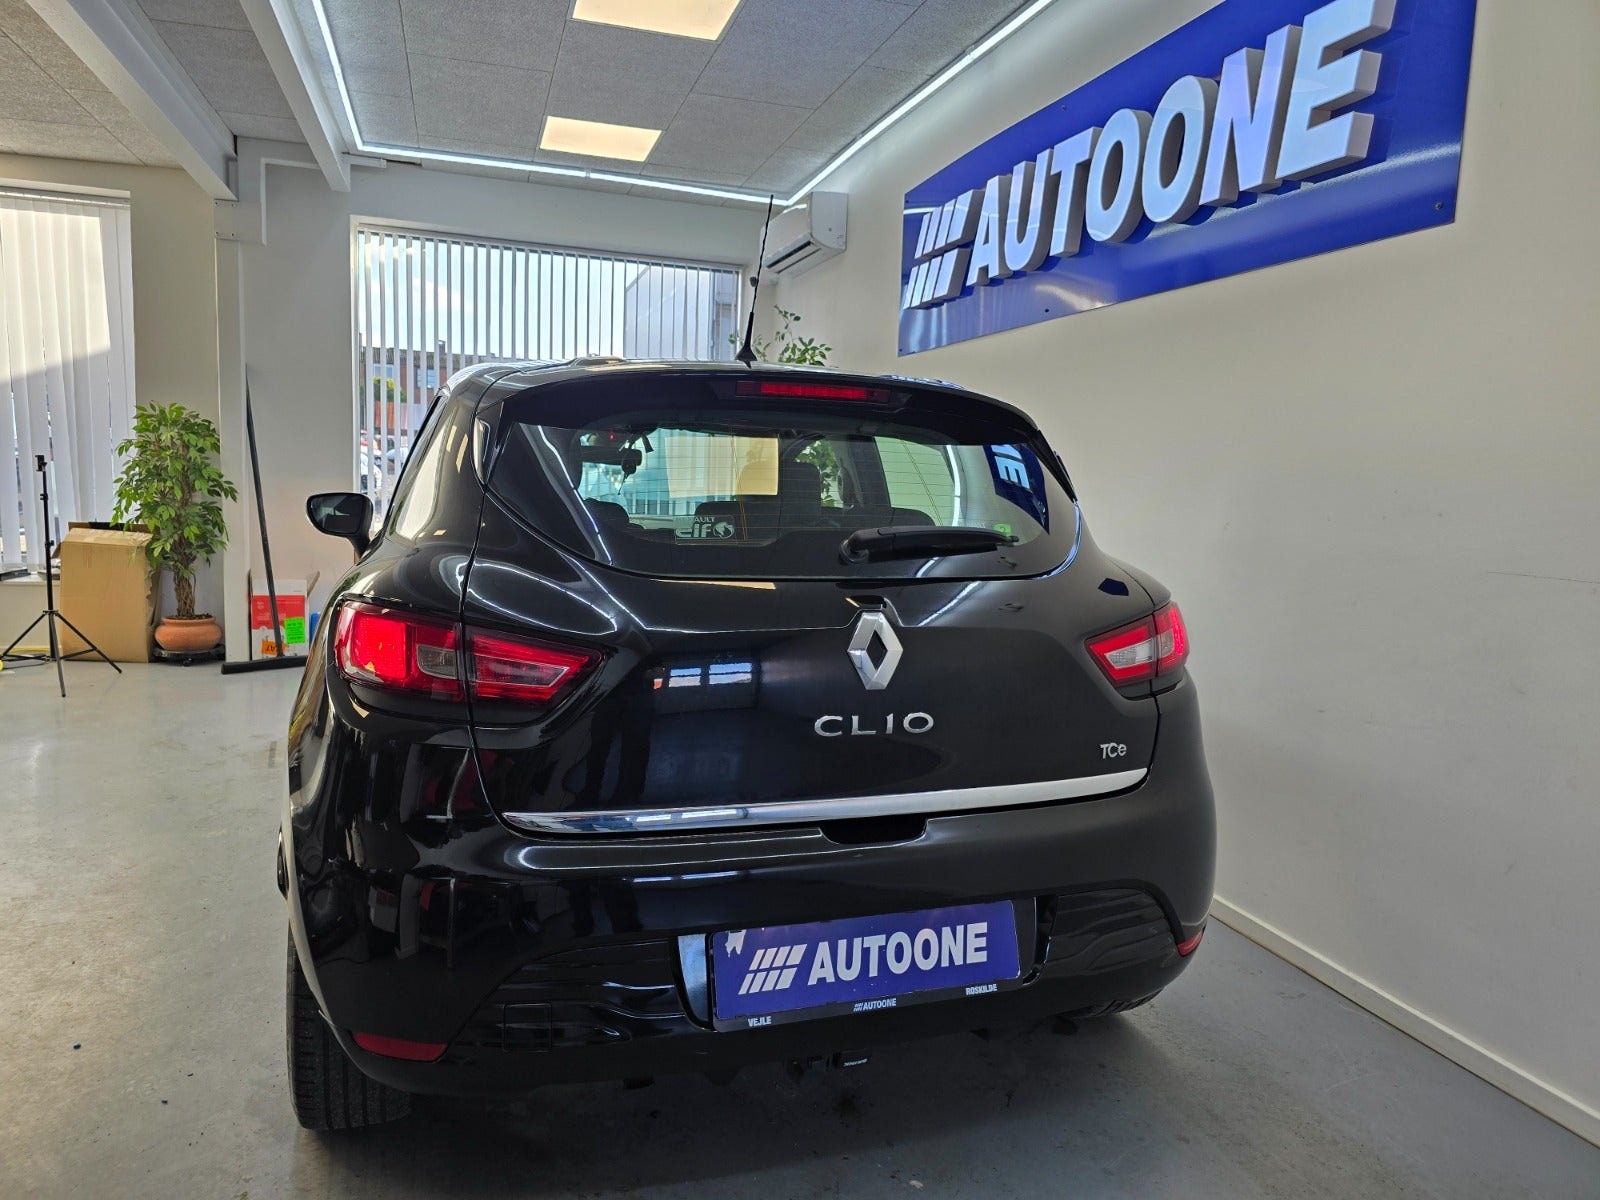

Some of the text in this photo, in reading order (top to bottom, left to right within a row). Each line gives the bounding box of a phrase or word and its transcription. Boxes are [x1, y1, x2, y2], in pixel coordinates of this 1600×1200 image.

[966, 0, 1395, 287] AUTOONE
[814, 711, 935, 738] CLIO
[1100, 742, 1128, 759] TCe
[807, 921, 989, 986] AUTOONE
[965, 983, 998, 997] ROSKILDE
[862, 997, 897, 1011] AUTOONE
[747, 1015, 772, 1027] VEJLE
